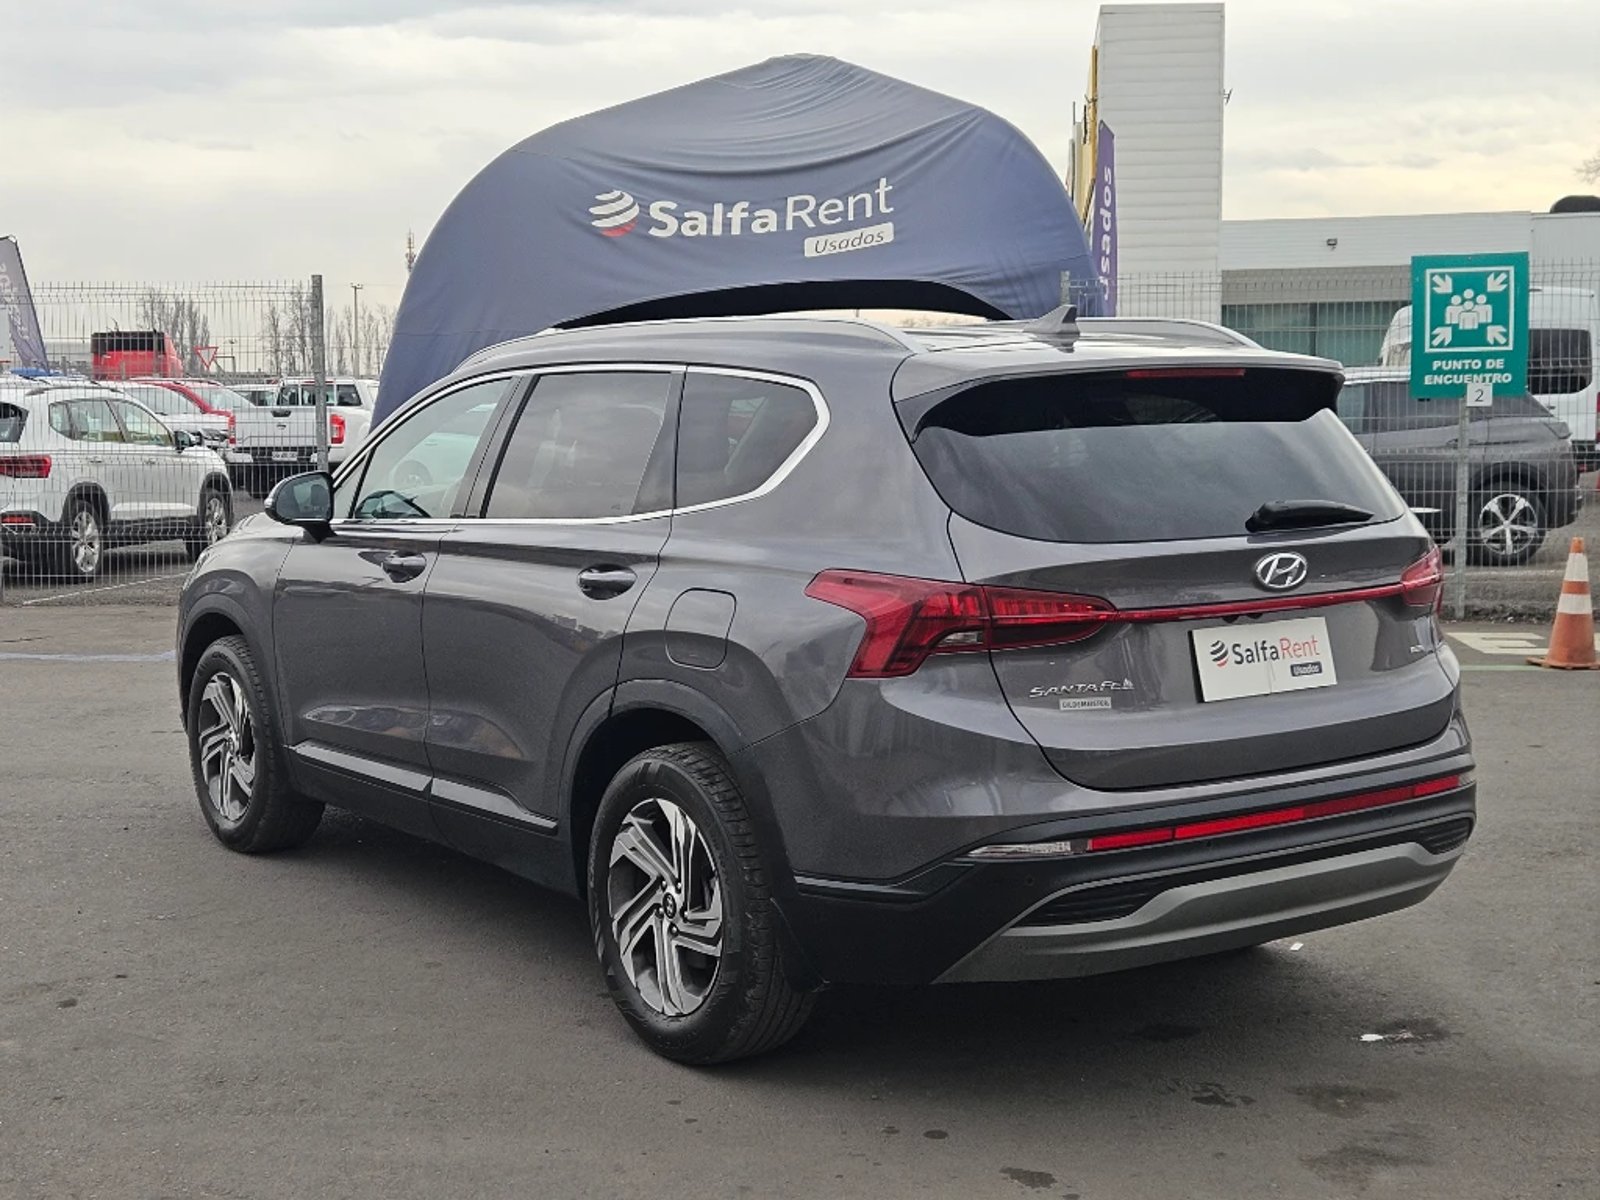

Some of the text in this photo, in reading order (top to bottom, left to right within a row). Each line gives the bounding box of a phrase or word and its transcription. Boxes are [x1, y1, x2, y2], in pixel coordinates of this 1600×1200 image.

[648, 177, 894, 237] SalfaRent
[814, 229, 886, 254] Usados
[1432, 358, 1505, 371] PUNTO DE
[1424, 373, 1512, 385] ENCUENTRO
[1474, 388, 1485, 402] 2
[1232, 635, 1320, 665] SalfaRent
